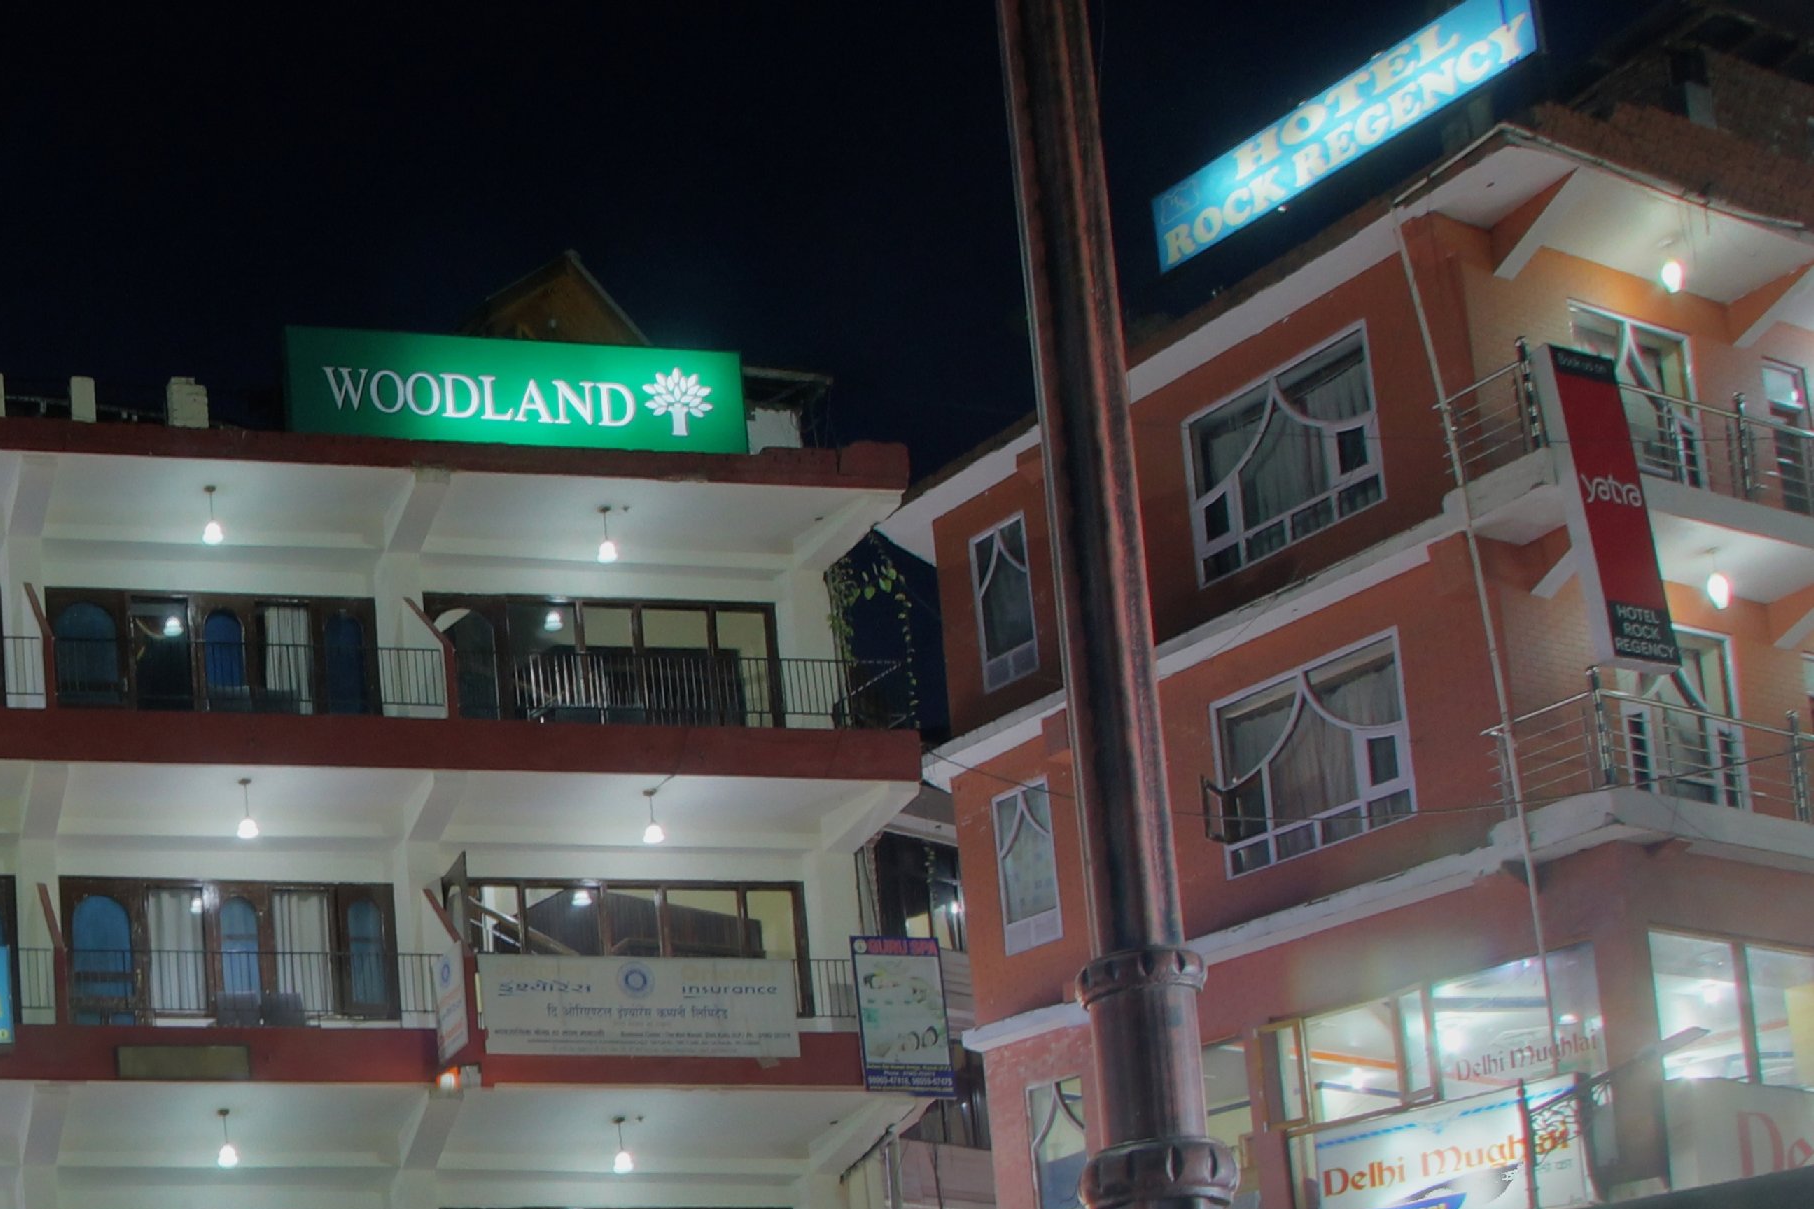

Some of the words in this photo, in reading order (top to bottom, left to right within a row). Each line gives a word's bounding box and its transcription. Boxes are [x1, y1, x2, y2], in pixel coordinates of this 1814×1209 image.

[1235, 24, 1460, 180] HOTEL
[1165, 166, 1285, 264] ROCK
[1292, 12, 1527, 188] REGENCY
[323, 365, 636, 427] WOODLAND
[1580, 473, 1643, 507] yatra
[1616, 604, 1659, 624] HOTEL
[1623, 622, 1659, 640] ROCK
[1615, 638, 1677, 659] REGENCY
[682, 985, 778, 995] insurance
[1455, 1049, 1505, 1081] Delhi
[1510, 1031, 1597, 1069] Mughlai
[1322, 1157, 1406, 1197] Delhi
[1421, 1119, 1571, 1177] Mughai
